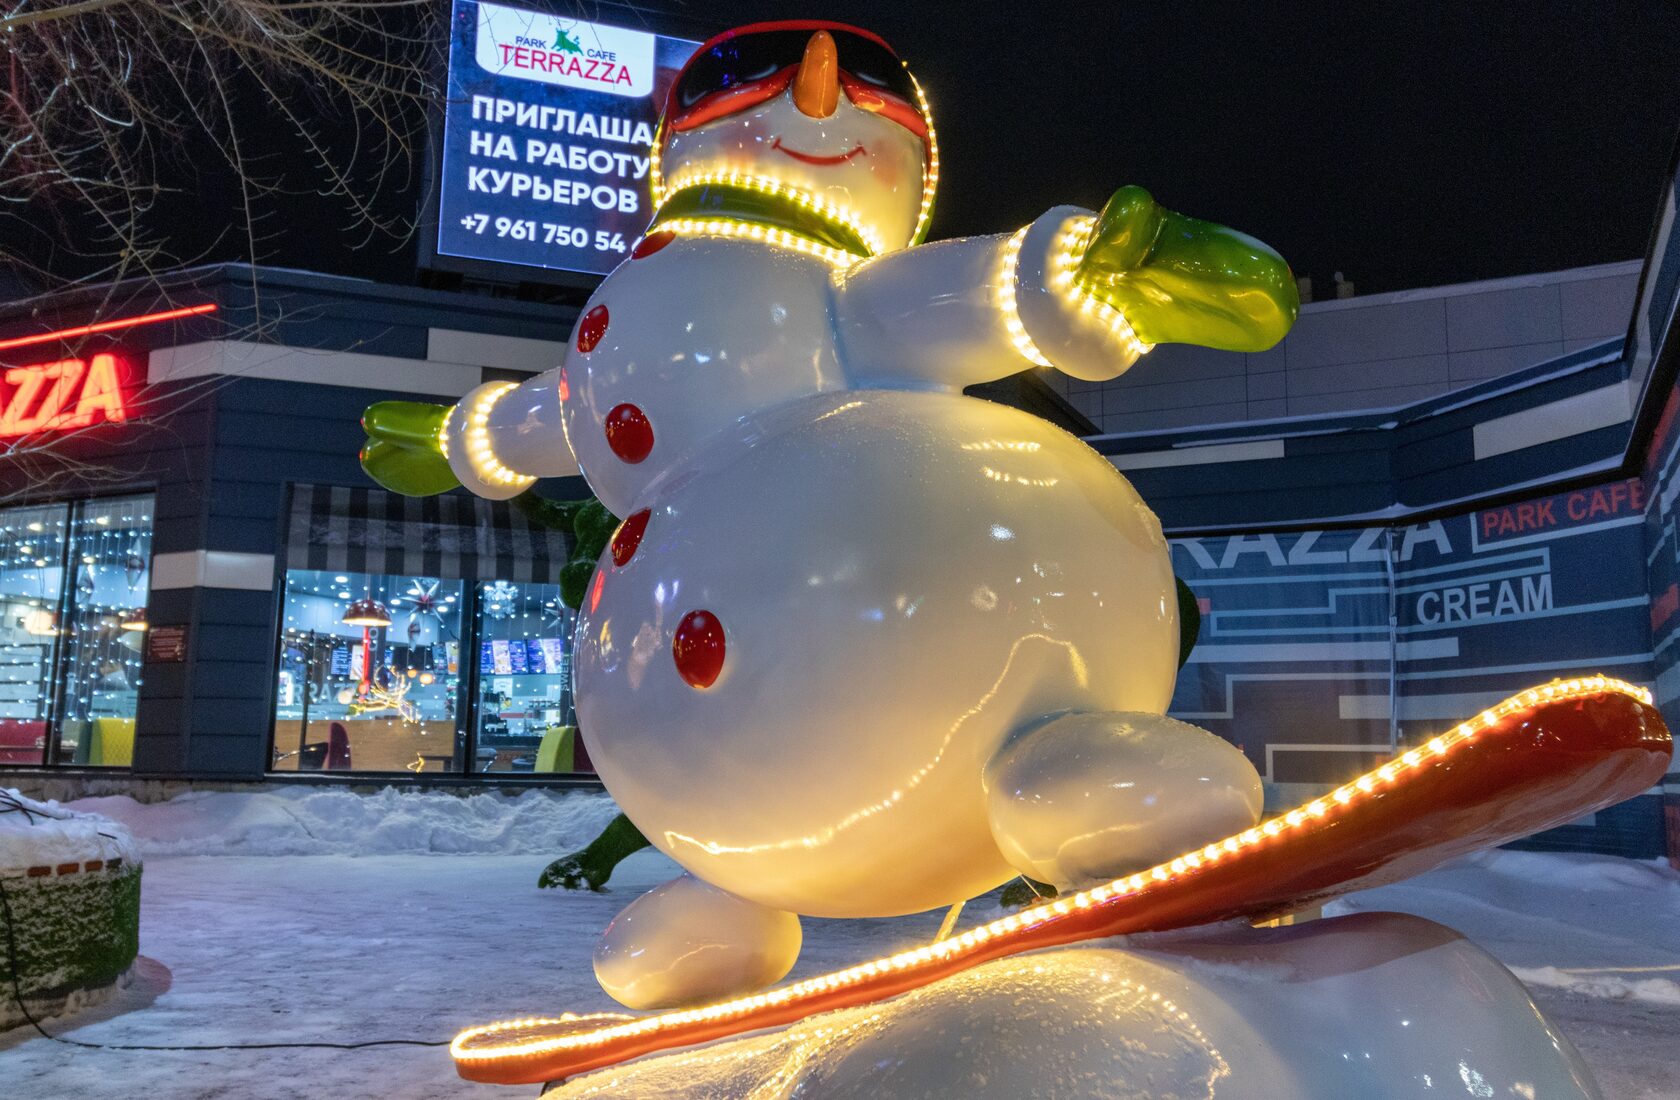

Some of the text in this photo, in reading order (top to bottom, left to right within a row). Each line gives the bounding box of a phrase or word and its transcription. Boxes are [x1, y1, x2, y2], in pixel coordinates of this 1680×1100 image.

[498, 43, 633, 87] TERRAZZA
[515, 36, 616, 62] PARK CAFE
[472, 95, 658, 147] ПРИГЛАША
[469, 130, 650, 180] НА РАБОТУ
[467, 166, 639, 213] КУРЬЕРОВ
[460, 213, 490, 235] +7
[494, 217, 537, 242] 961
[542, 222, 590, 248] 750
[594, 230, 627, 254] 54
[1483, 501, 1557, 538] PARK
[1416, 573, 1554, 626] CREAM
